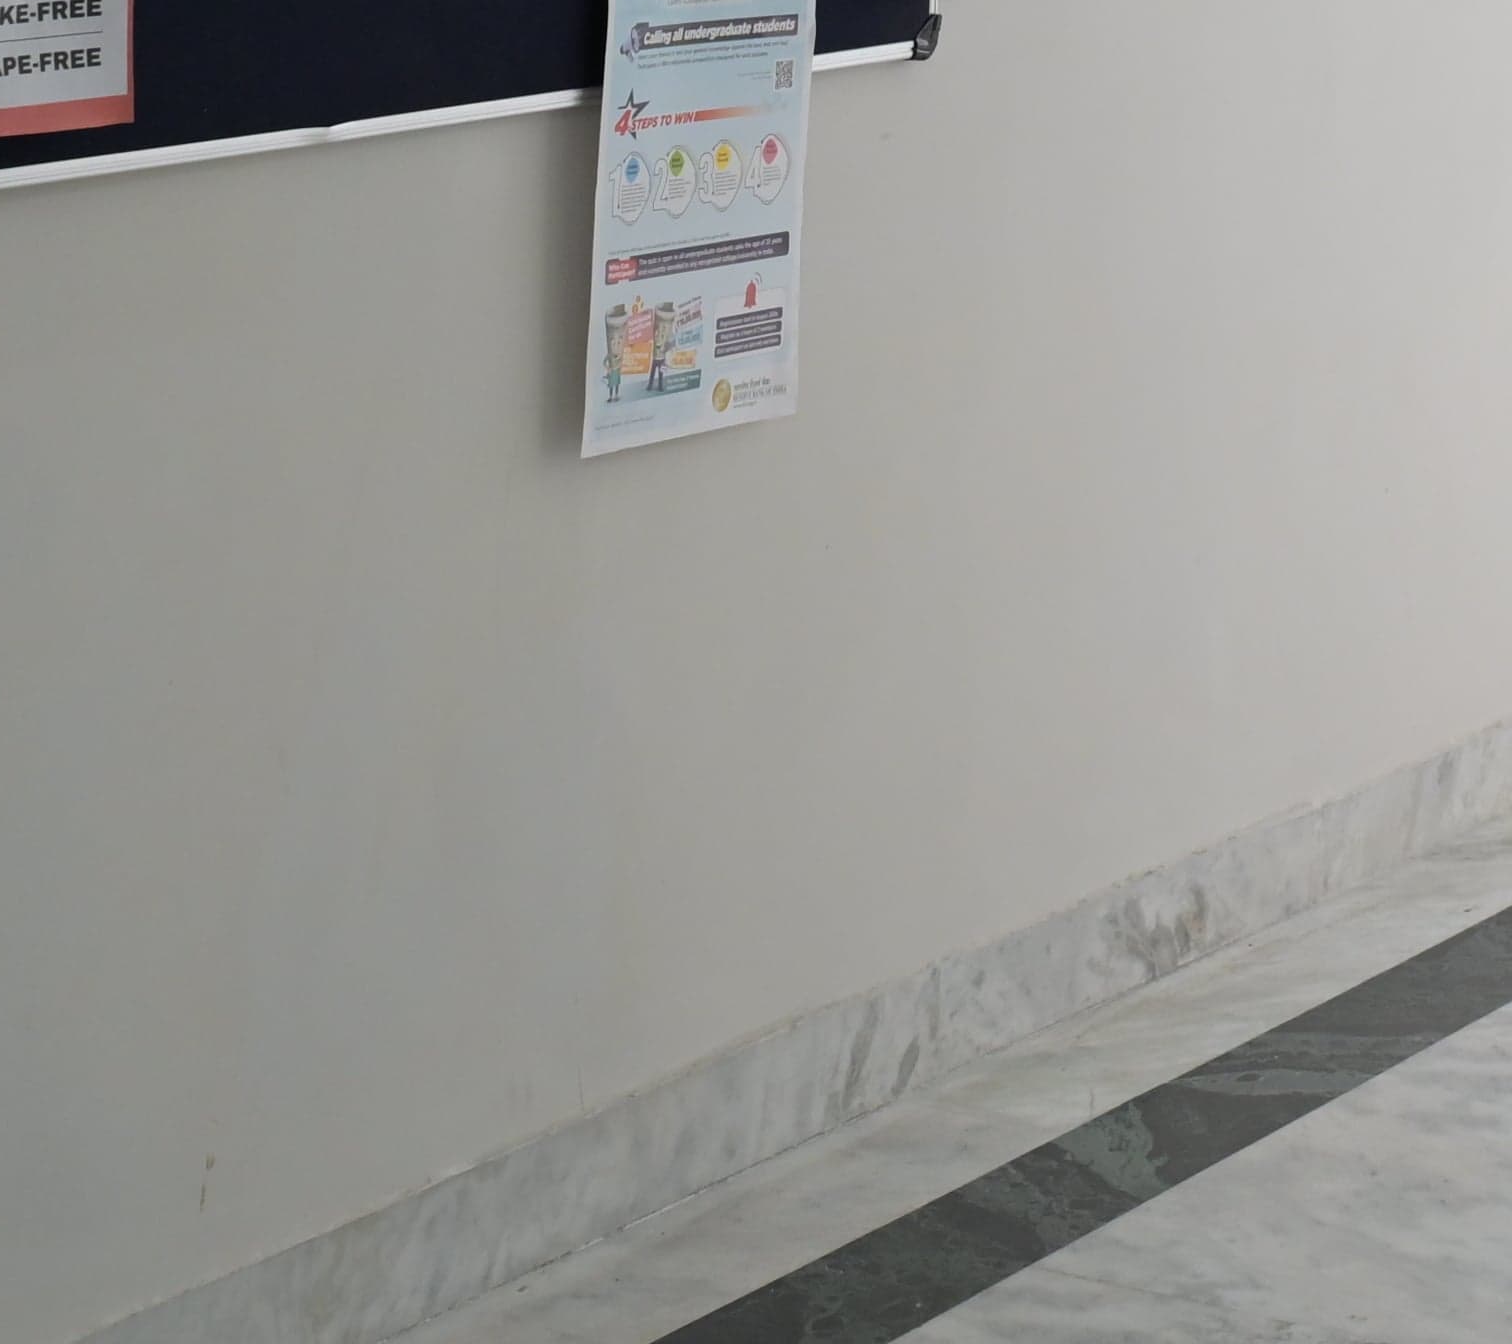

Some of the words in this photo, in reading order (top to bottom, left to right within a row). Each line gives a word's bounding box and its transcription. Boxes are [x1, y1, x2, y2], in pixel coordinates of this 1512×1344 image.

[643, 30, 672, 46] Calling
[672, 26, 683, 42] all
[684, 21, 751, 41] undergraduate
[752, 16, 796, 34] students
[614, 109, 632, 136] 4
[631, 115, 658, 132] STEPS
[660, 114, 673, 127] TO
